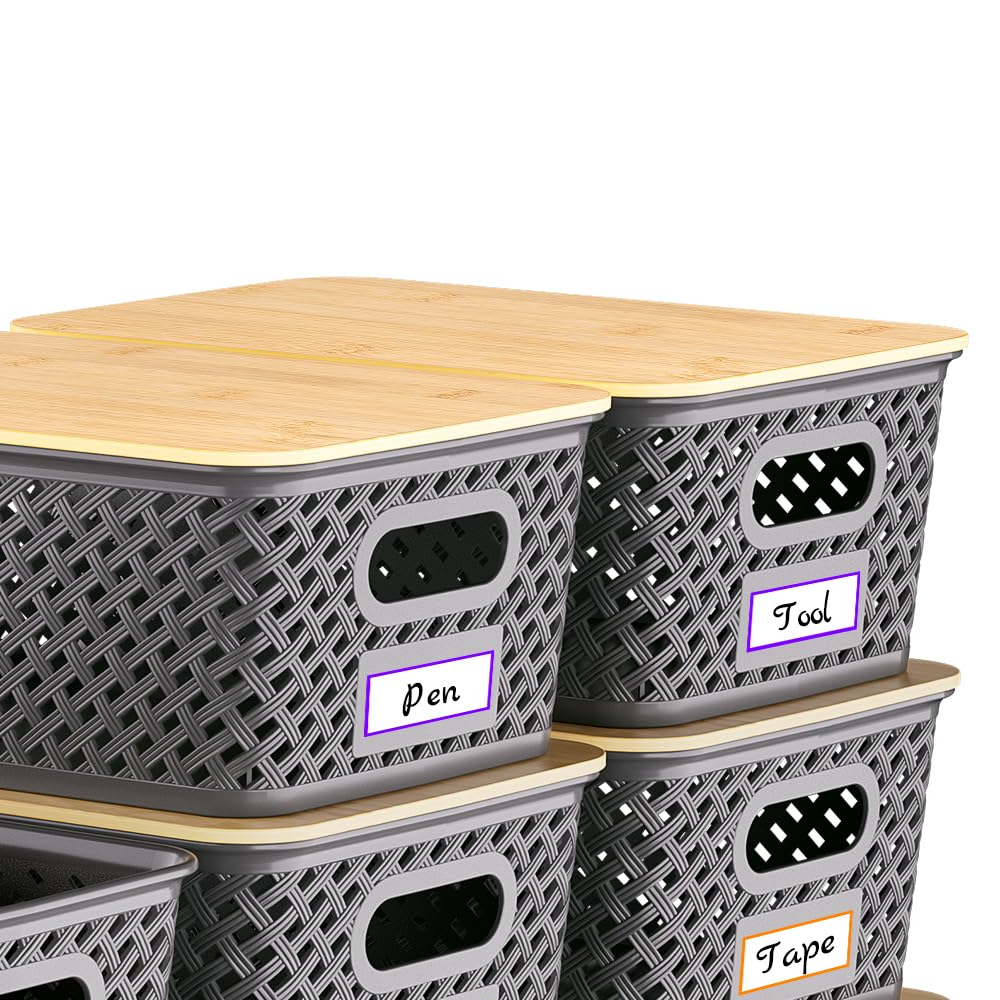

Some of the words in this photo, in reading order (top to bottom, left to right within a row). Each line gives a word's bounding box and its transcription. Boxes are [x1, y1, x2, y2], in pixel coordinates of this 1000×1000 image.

[772, 589, 832, 631] Tool
[402, 682, 461, 717] Pen
[756, 935, 835, 975] Tape
